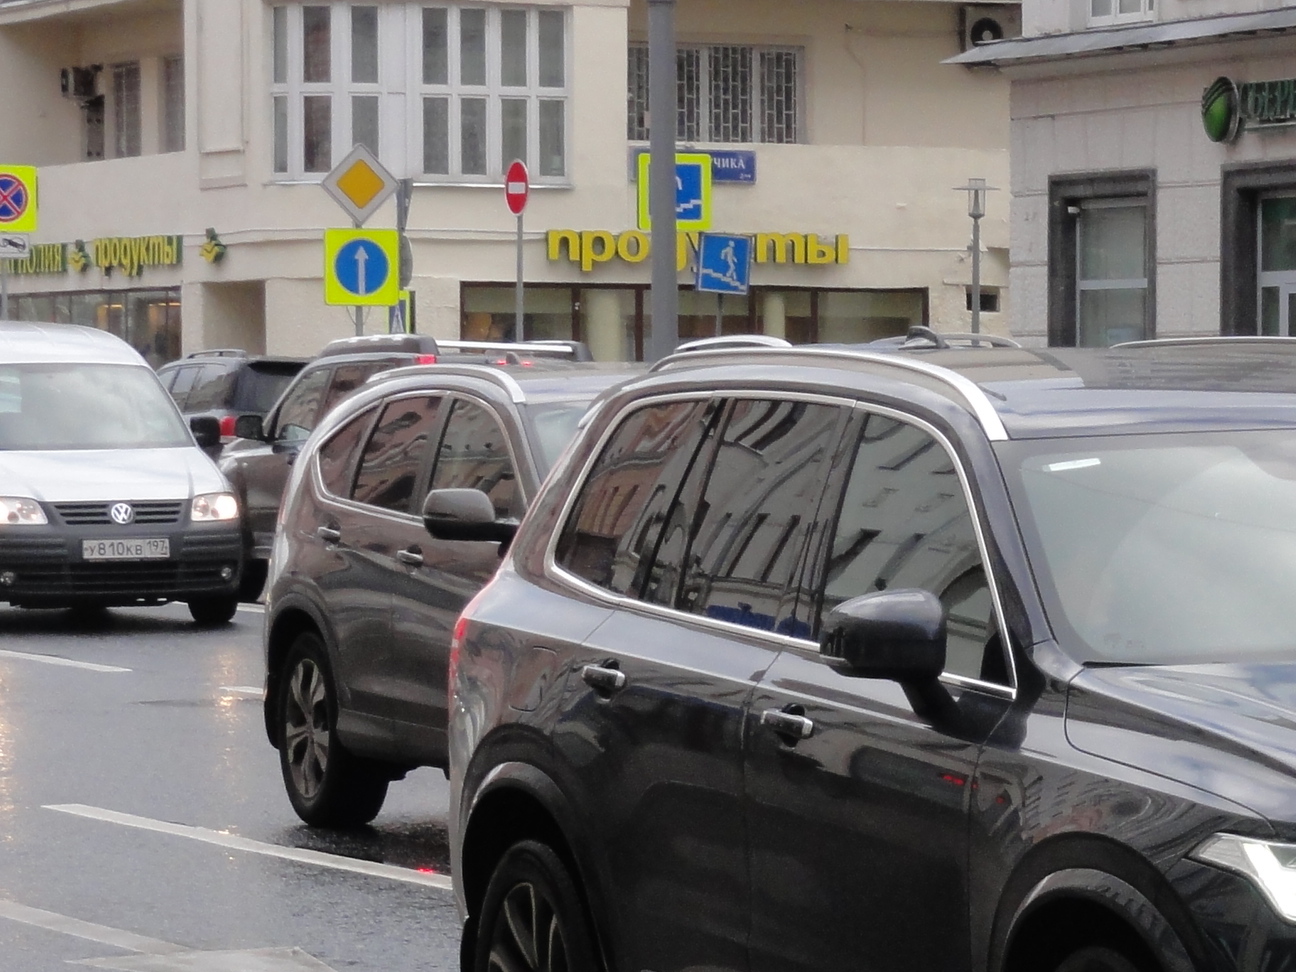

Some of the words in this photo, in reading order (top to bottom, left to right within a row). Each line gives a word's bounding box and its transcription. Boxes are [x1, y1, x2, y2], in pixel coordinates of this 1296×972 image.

[713, 157, 746, 169] ЧИКА
[94, 235, 178, 277] продукты
[146, 540, 165, 552] 197
